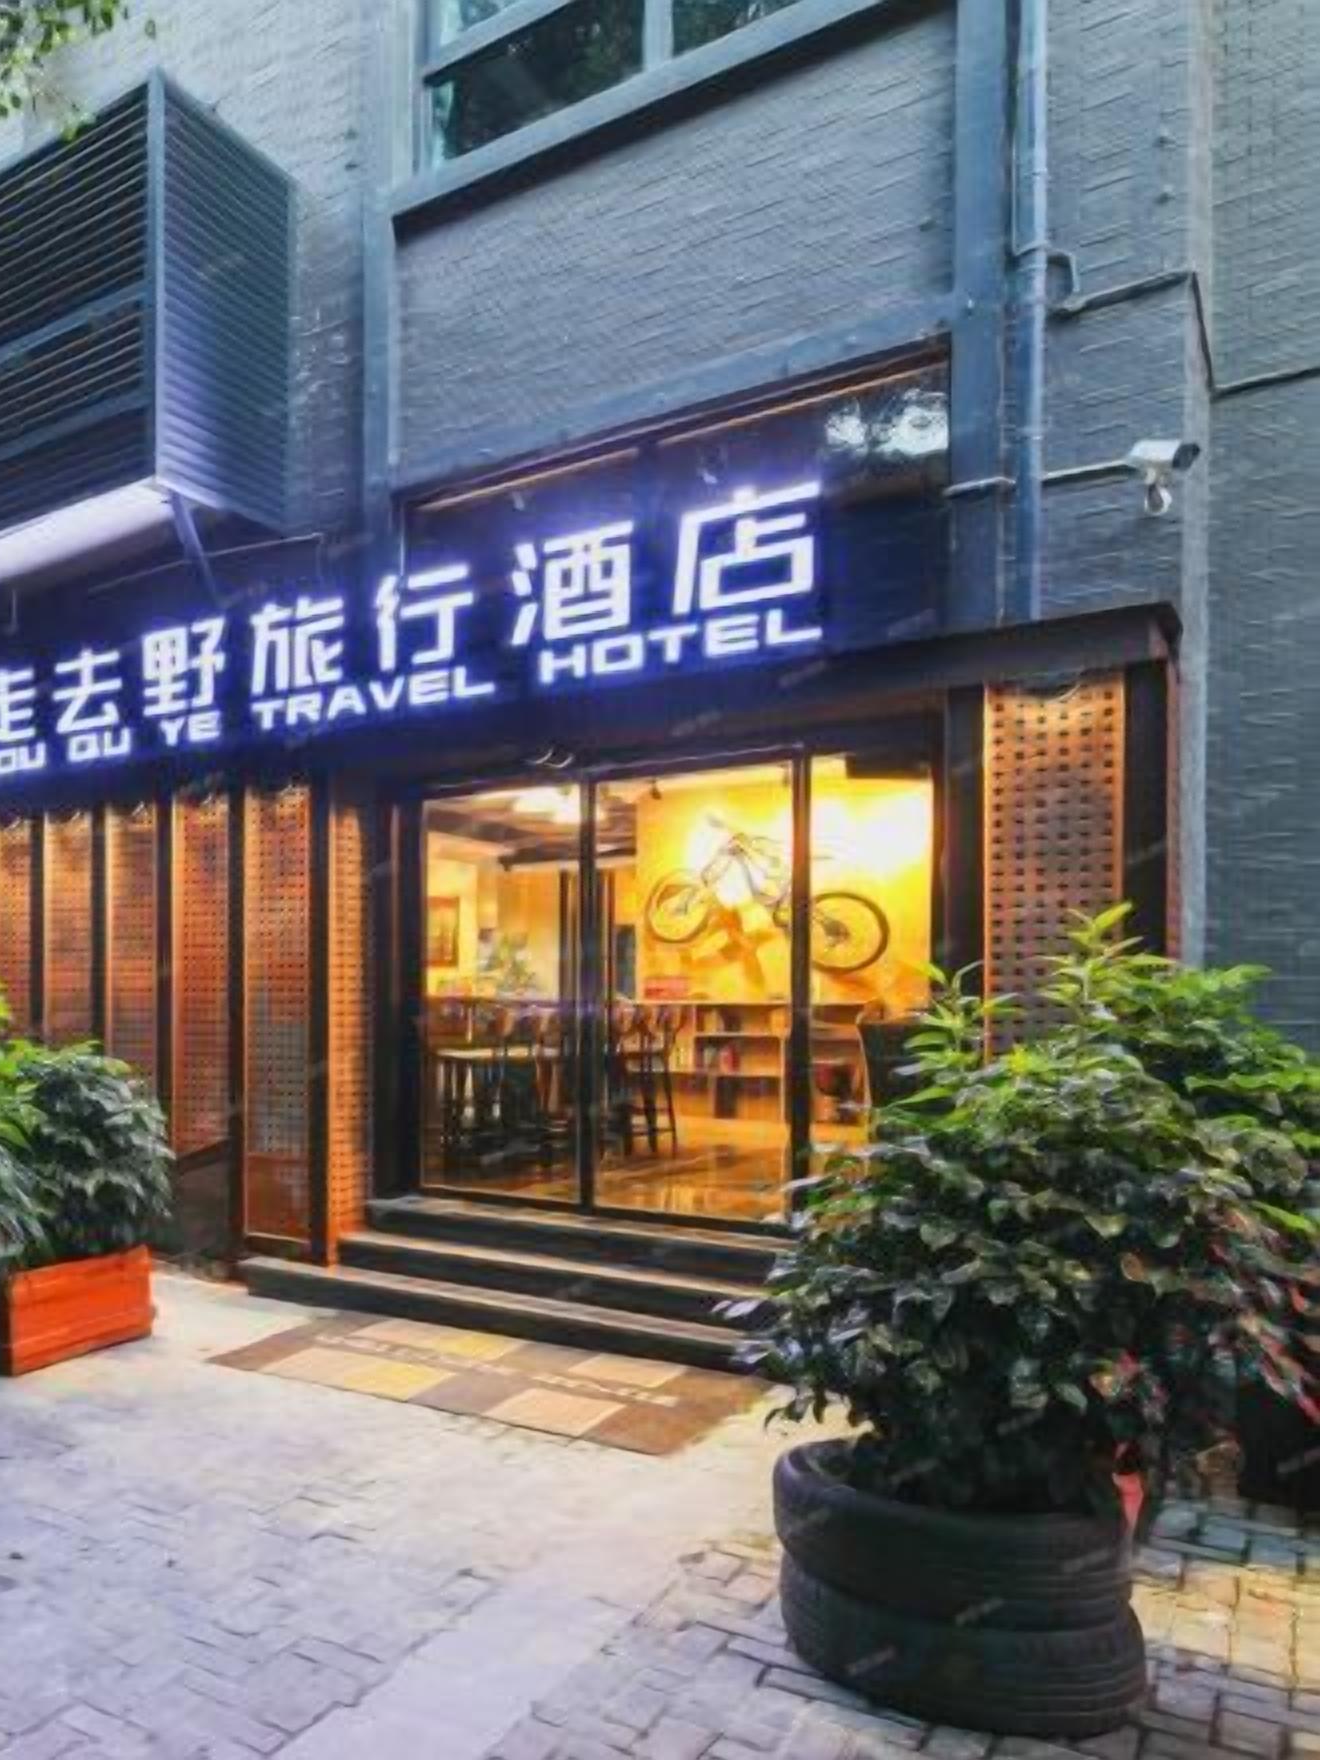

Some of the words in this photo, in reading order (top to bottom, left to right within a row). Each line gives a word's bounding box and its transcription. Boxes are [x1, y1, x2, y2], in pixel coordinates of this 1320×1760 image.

[159, 709, 222, 747] YE
[250, 665, 496, 731] TRAVEL
[539, 607, 823, 685] HOTEL
